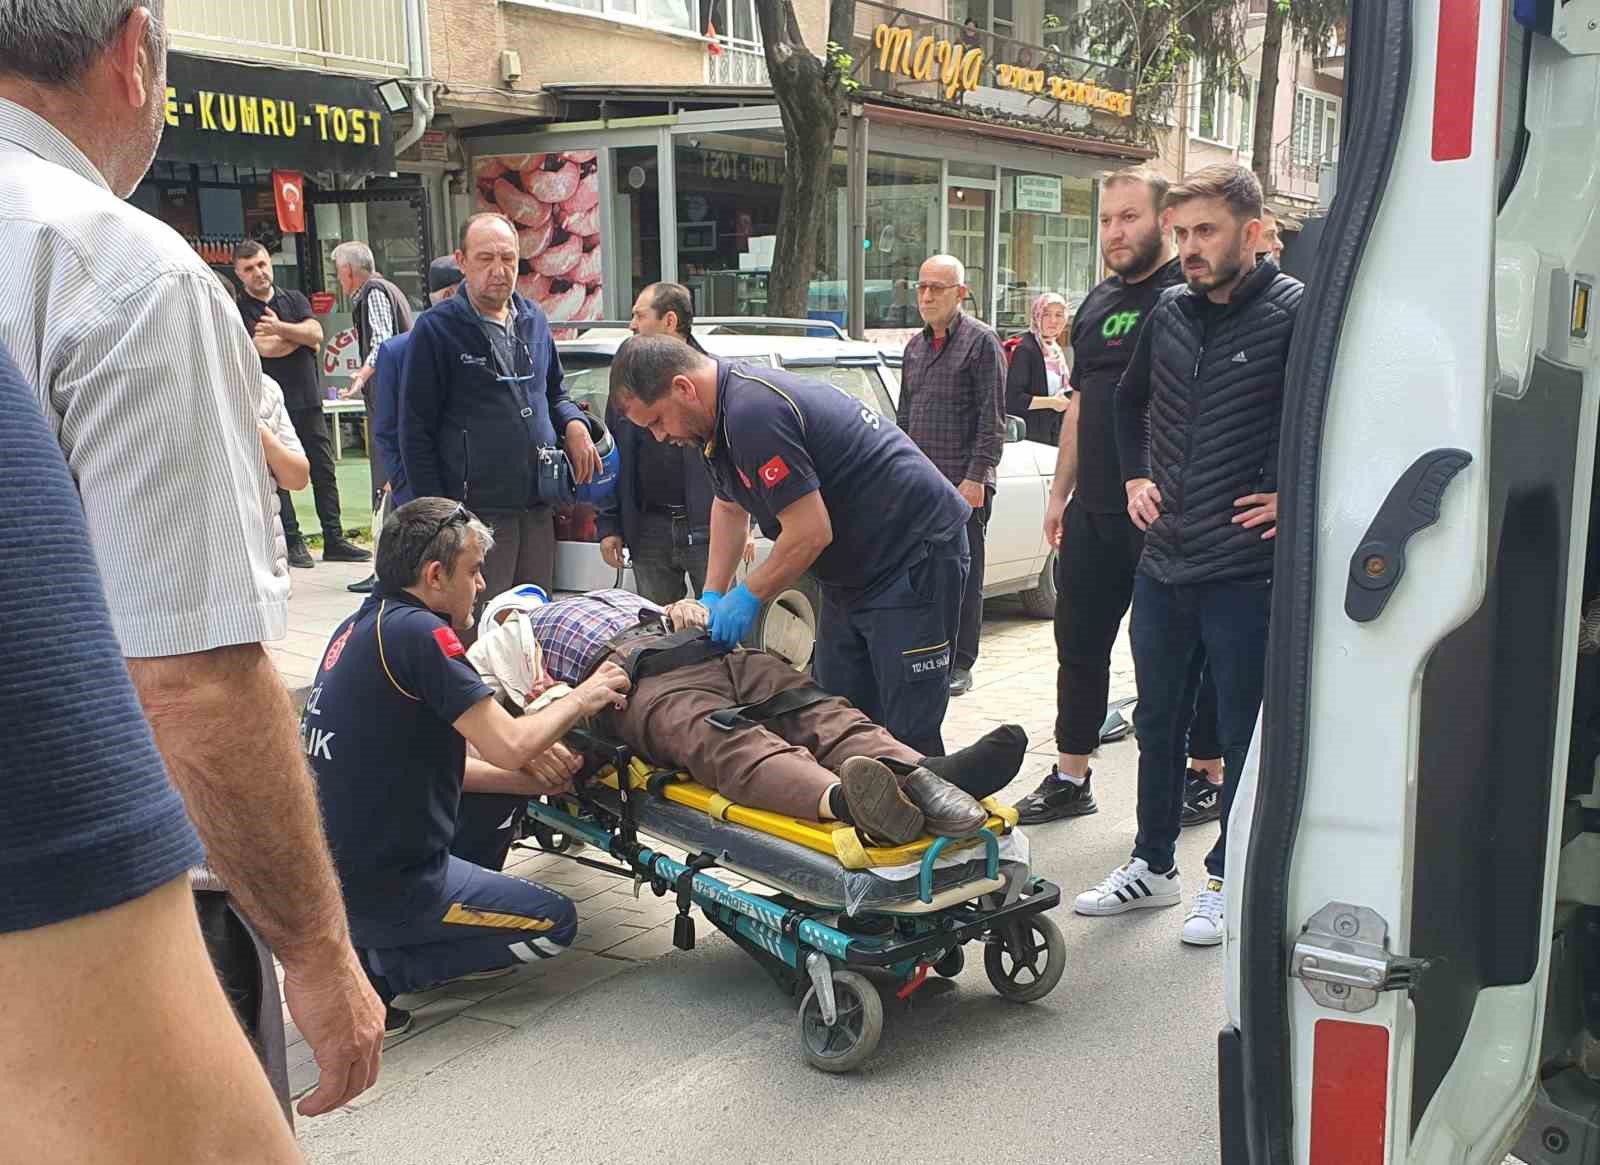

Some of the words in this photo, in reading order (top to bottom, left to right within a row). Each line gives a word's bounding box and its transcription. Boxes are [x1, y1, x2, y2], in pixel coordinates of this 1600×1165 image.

[199, 91, 297, 137] KUMRU
[315, 103, 382, 145] TOST
[1102, 312, 1140, 336] OFF
